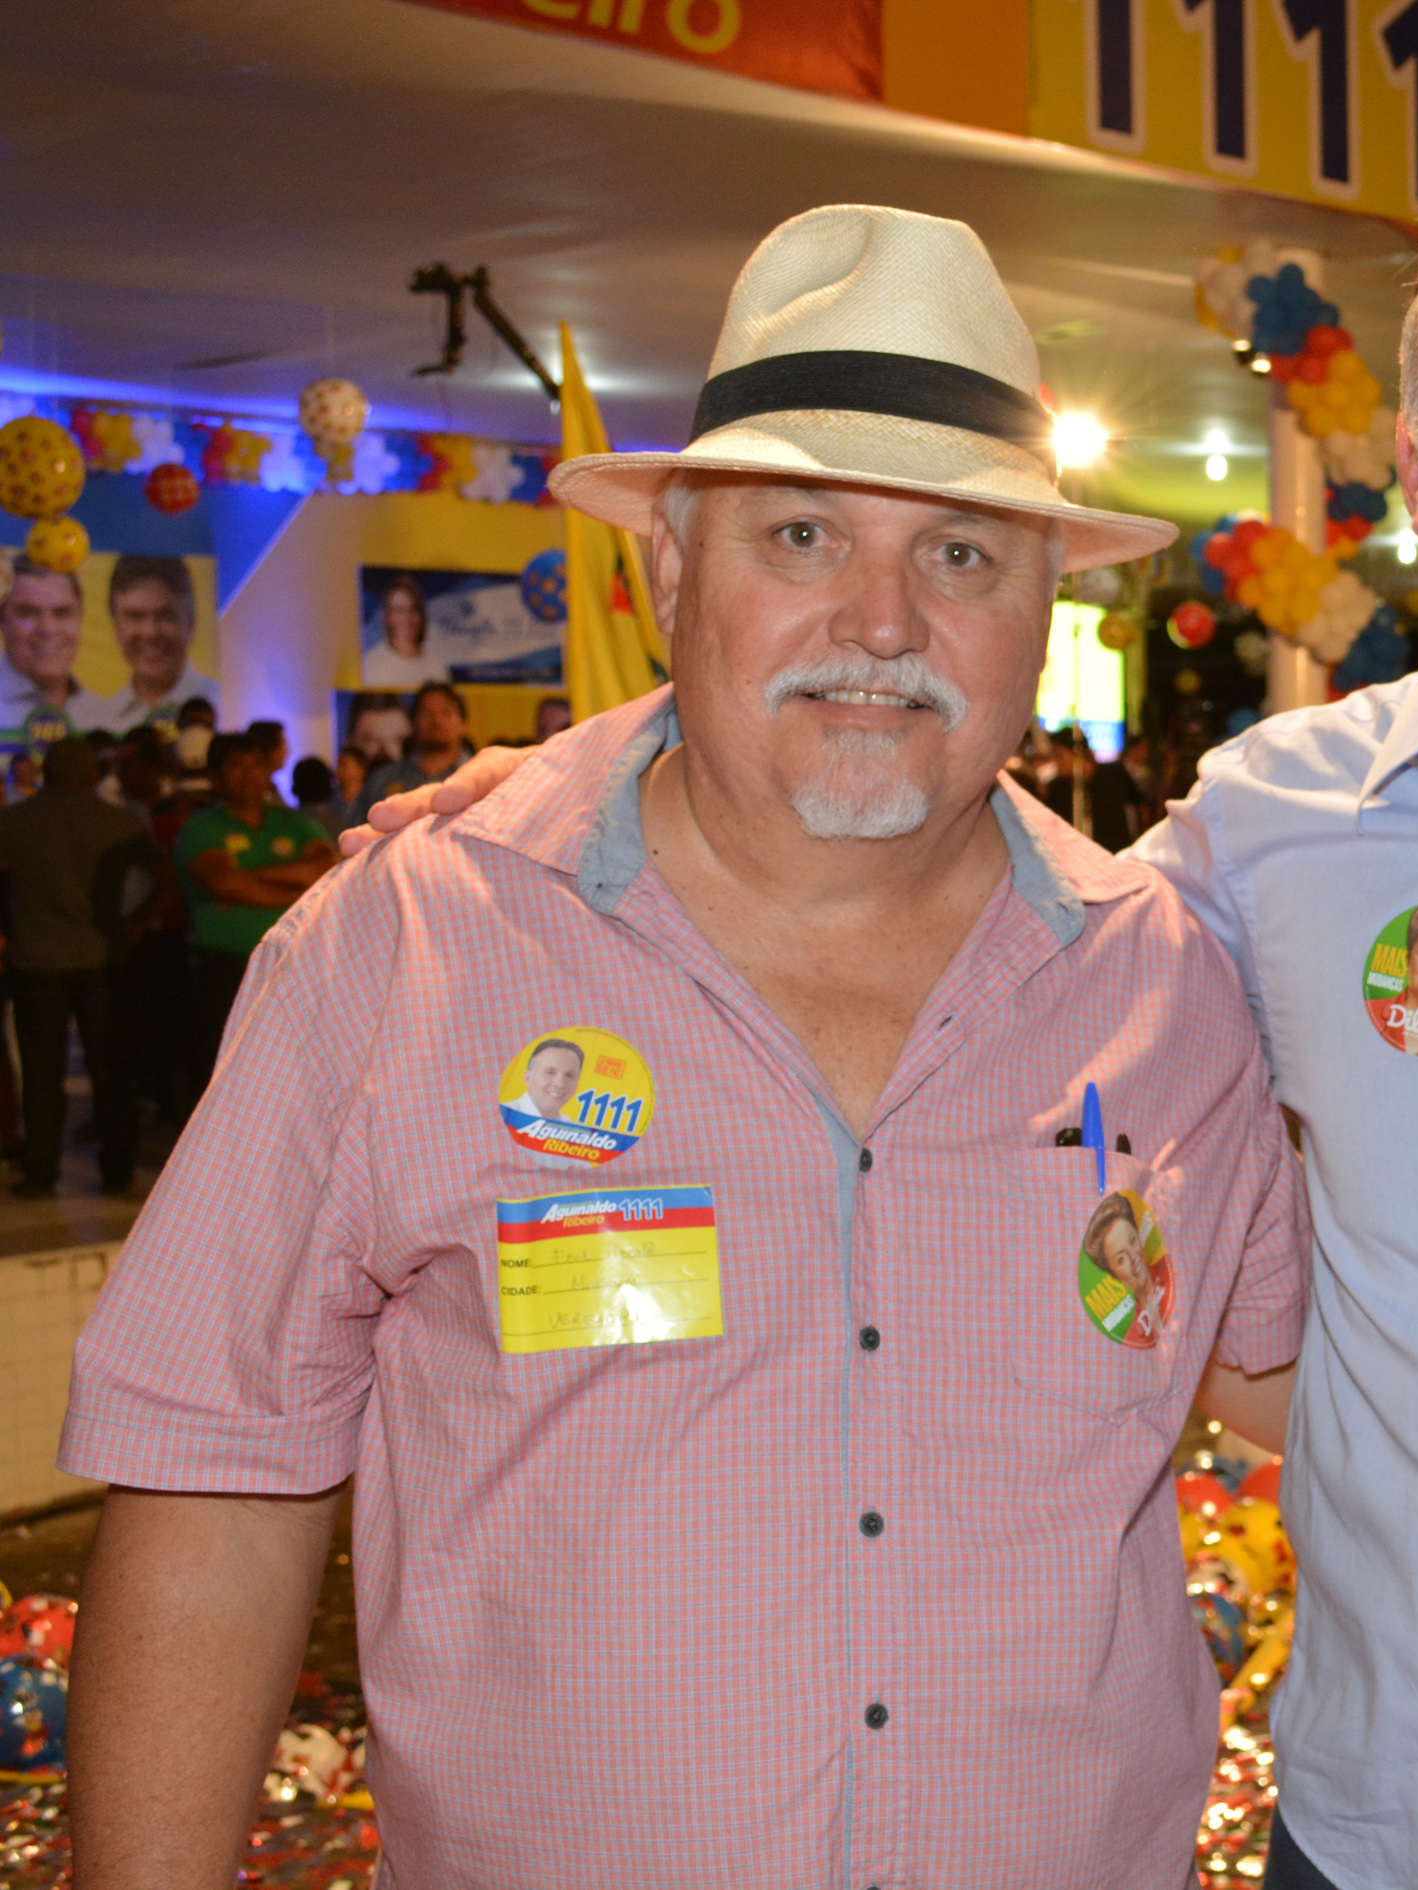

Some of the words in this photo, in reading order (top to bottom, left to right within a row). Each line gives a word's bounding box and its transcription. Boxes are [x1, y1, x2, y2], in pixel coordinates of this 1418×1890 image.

[1370, 943, 1408, 979] MAIS
[577, 1087, 644, 1133] 1111
[517, 1119, 617, 1151] Aguinaldo
[543, 1138, 600, 1160] Ribeiro
[540, 1200, 616, 1224] Aguinaldo
[618, 1198, 664, 1221] 1111
[563, 1214, 605, 1228] Ribeiro
[501, 1285, 542, 1297] CIDADE:
[1084, 1273, 1127, 1321] MAIS
